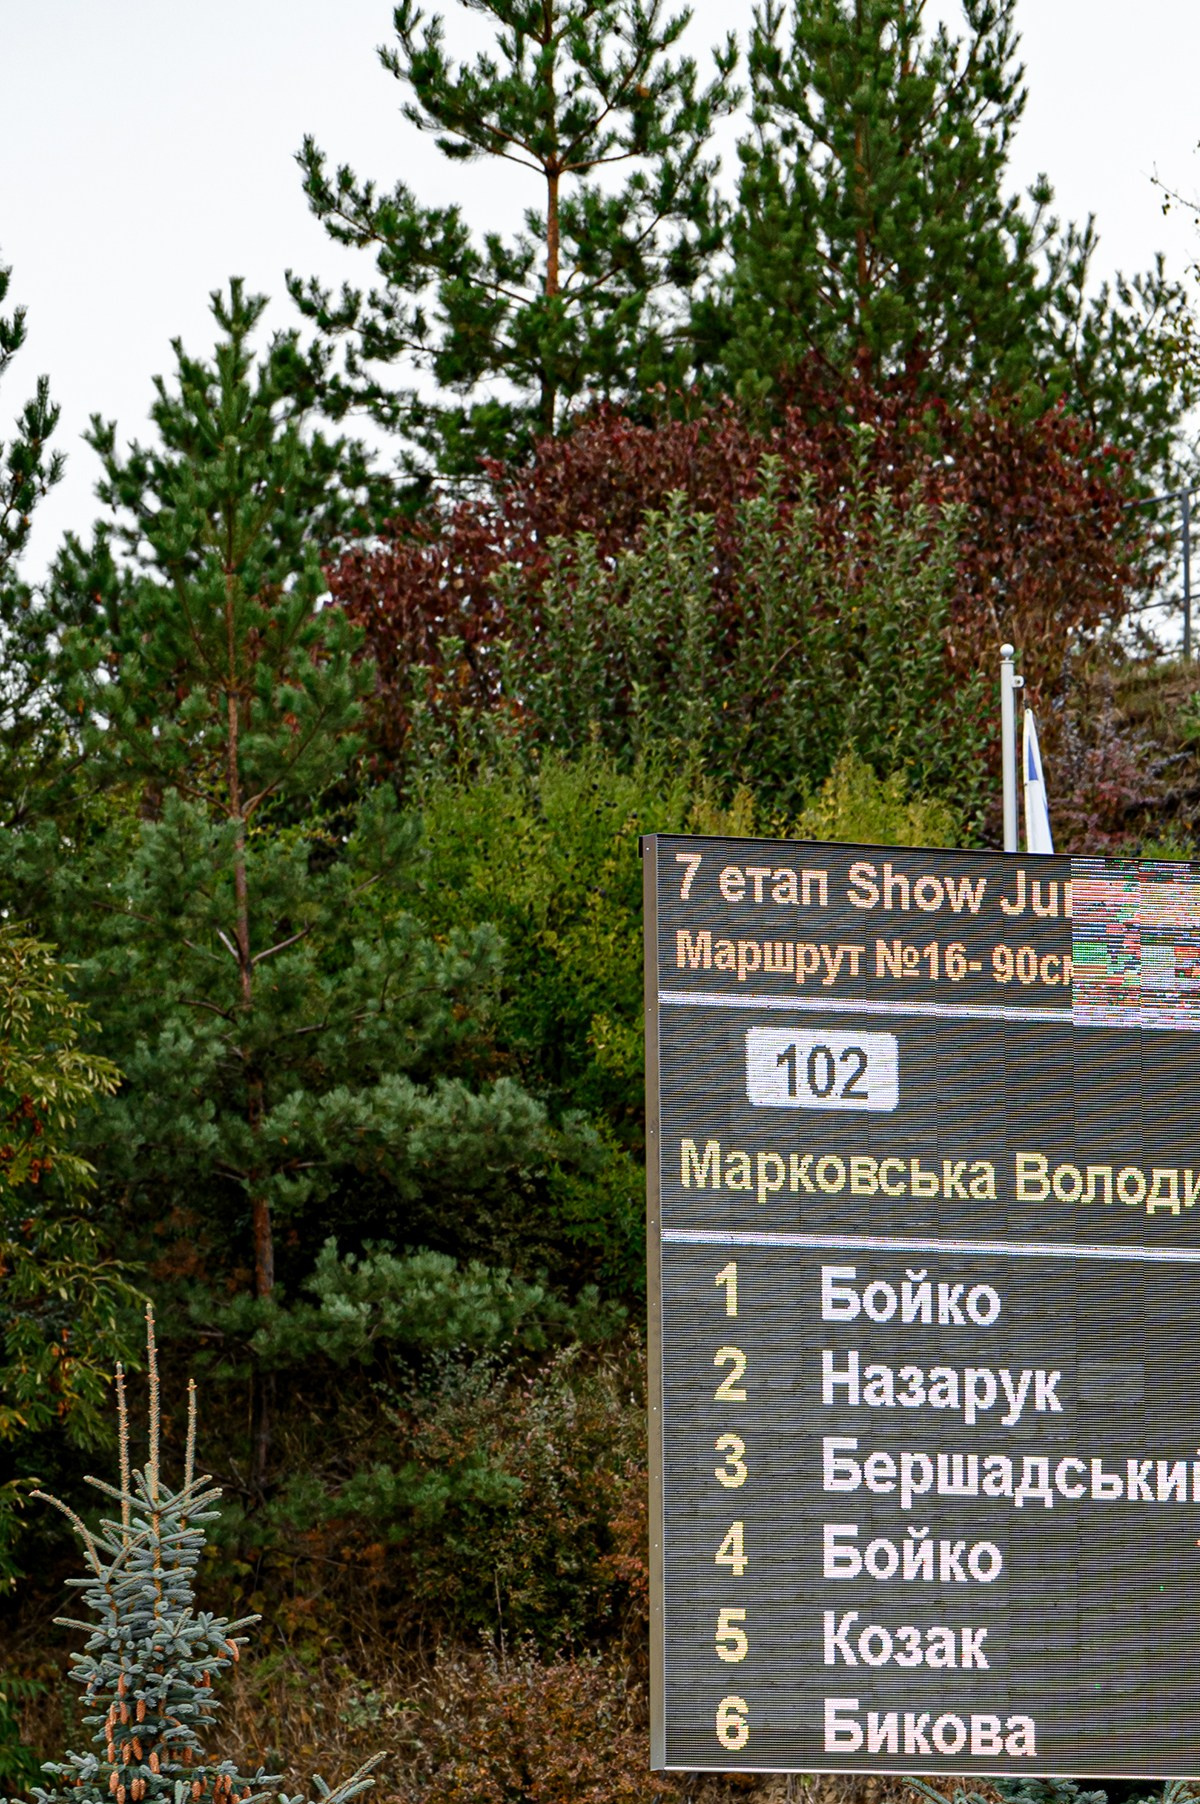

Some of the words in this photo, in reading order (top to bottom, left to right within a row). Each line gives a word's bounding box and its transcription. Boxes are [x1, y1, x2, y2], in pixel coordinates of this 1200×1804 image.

[674, 853, 703, 900] 7
[719, 865, 829, 907] етап
[847, 861, 987, 915] Show
[1000, 869, 1073, 918] Ju
[675, 931, 866, 985] Маршрут
[775, 1044, 870, 1100] 102
[680, 1138, 998, 1204] Марковська
[714, 1261, 739, 1317] 1
[820, 1265, 1002, 1326] Бойко
[713, 1346, 748, 1402] 2
[820, 1350, 1063, 1425] Назарук
[713, 1433, 748, 1489] 3
[713, 1521, 749, 1577] 4
[822, 1523, 1004, 1583] Бойко
[714, 1608, 749, 1663] 5
[822, 1611, 991, 1670] Козак
[715, 1696, 750, 1751] 6
[822, 1698, 1038, 1758] Бикова
